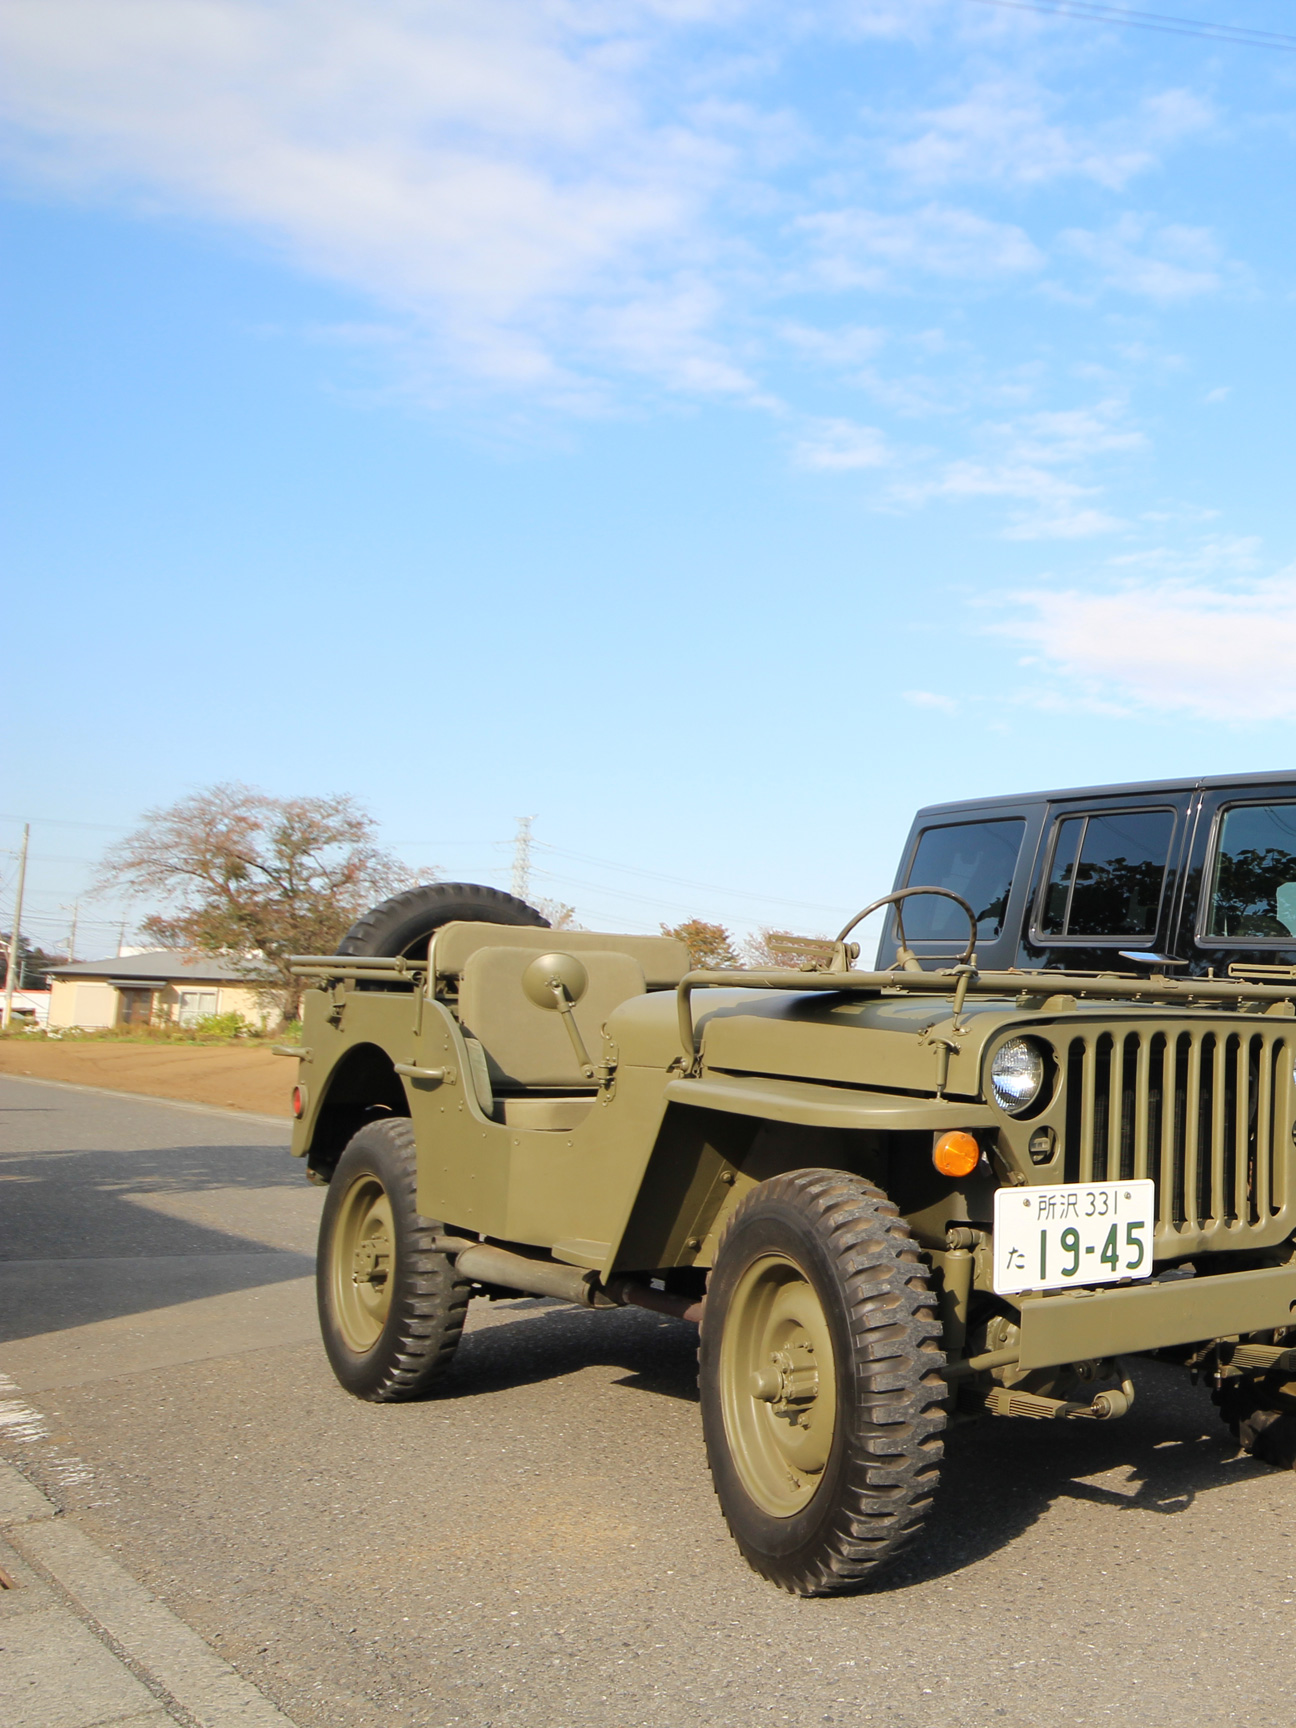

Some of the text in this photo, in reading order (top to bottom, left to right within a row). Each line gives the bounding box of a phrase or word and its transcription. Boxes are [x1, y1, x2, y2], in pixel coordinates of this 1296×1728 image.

[1037, 1190, 1118, 1221] 所沢 331
[1006, 1220, 1145, 1281] た 19-45
